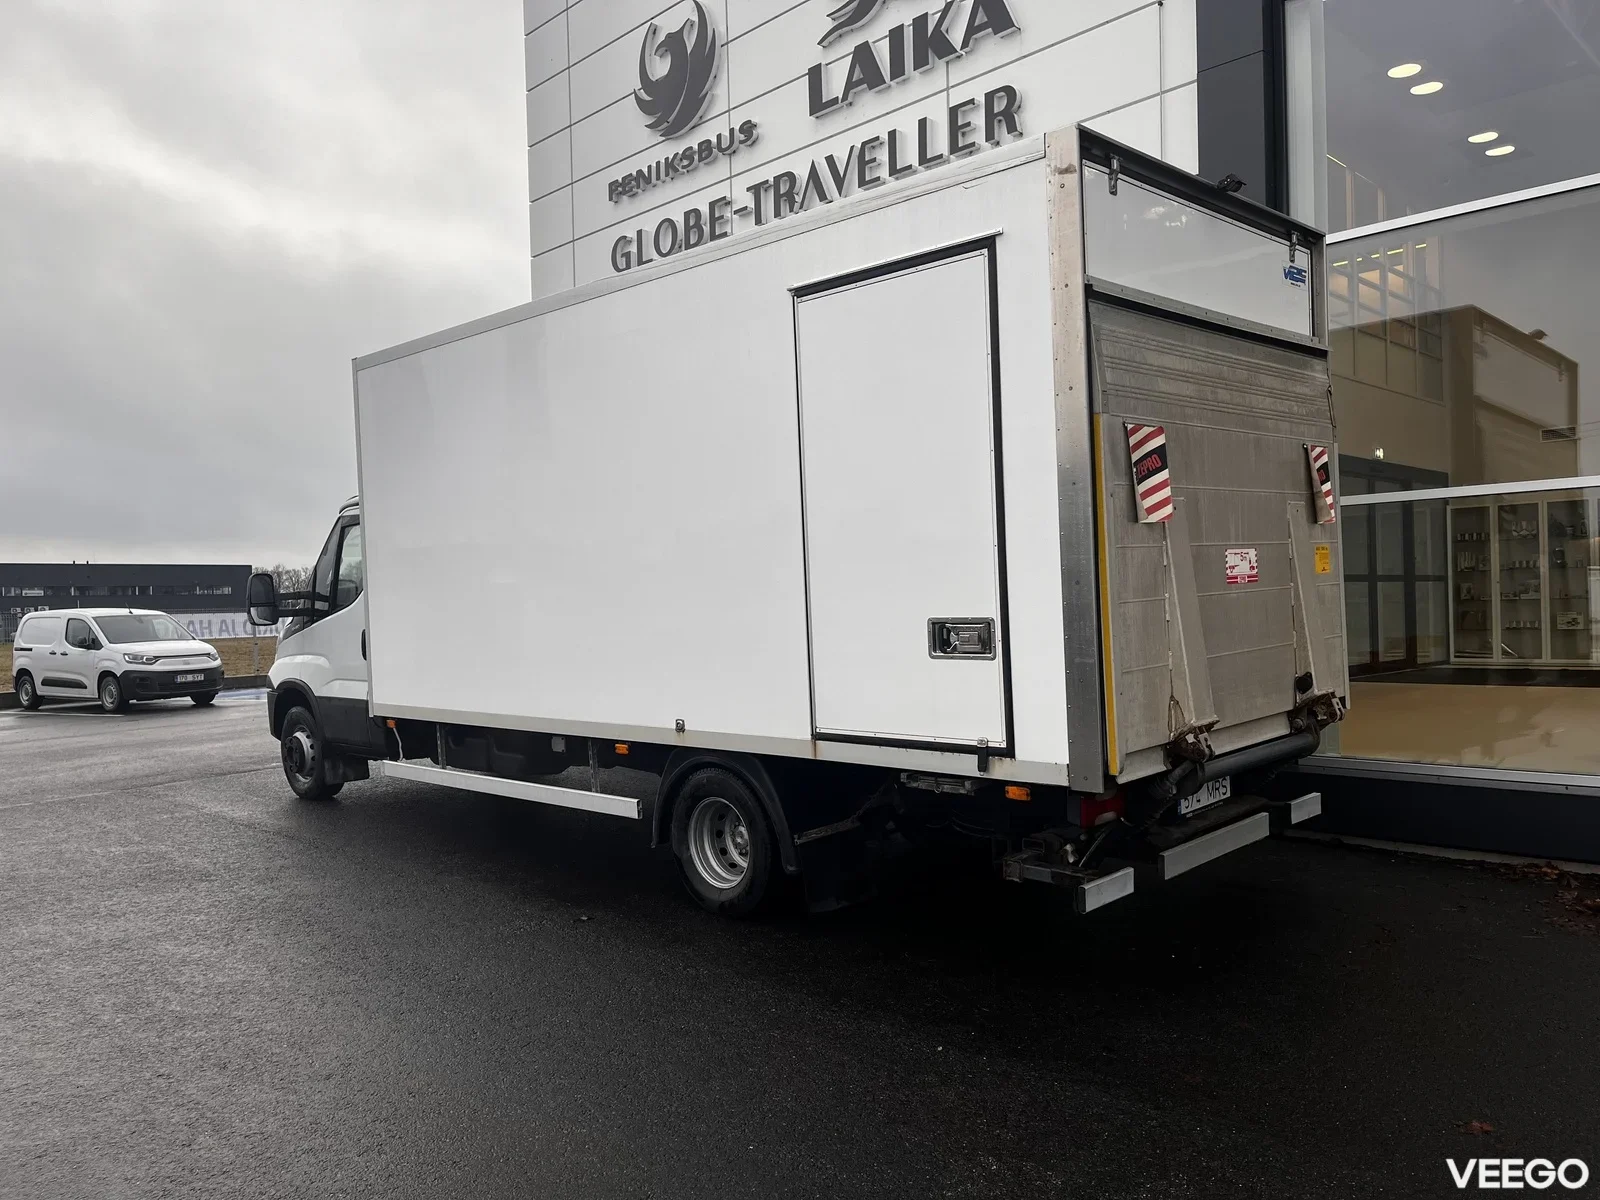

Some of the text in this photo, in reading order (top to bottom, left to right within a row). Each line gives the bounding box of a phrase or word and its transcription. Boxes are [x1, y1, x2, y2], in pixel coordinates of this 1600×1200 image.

[808, 0, 1020, 117] LAIKA
[608, 119, 758, 203] FENIKSBUS
[611, 84, 1021, 272] GLOBE-TRAVELLER
[1136, 453, 1162, 479] ZEPRO
[1206, 777, 1228, 801] MRS
